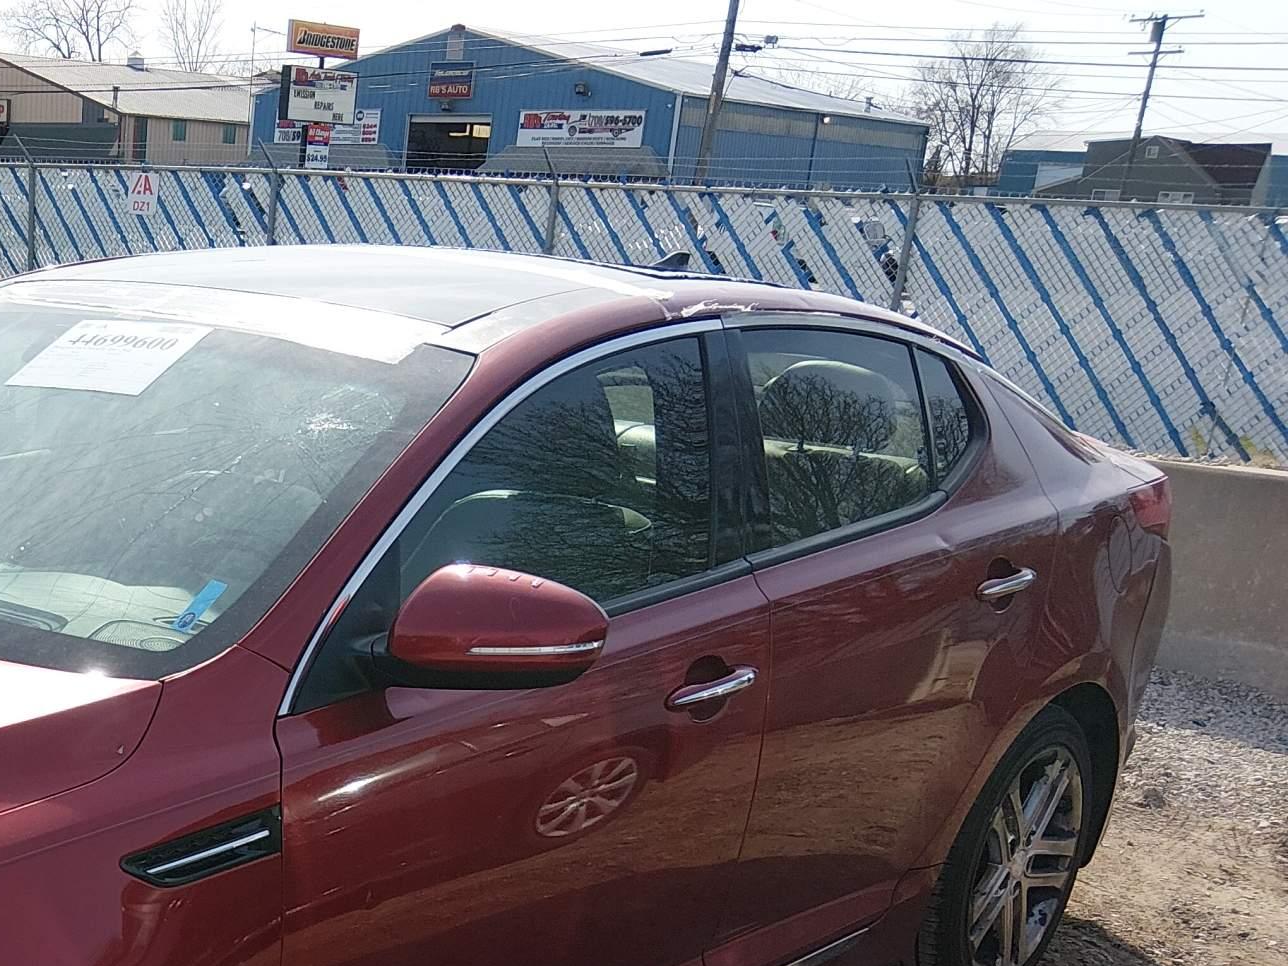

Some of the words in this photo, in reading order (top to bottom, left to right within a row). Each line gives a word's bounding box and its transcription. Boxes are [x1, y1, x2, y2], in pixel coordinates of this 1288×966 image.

[297, 30, 357, 51] BRIDGESTONE
[447, 85, 468, 94] AUTO
[314, 101, 335, 112] REPAIRS
[68, 333, 179, 351] 44699600
